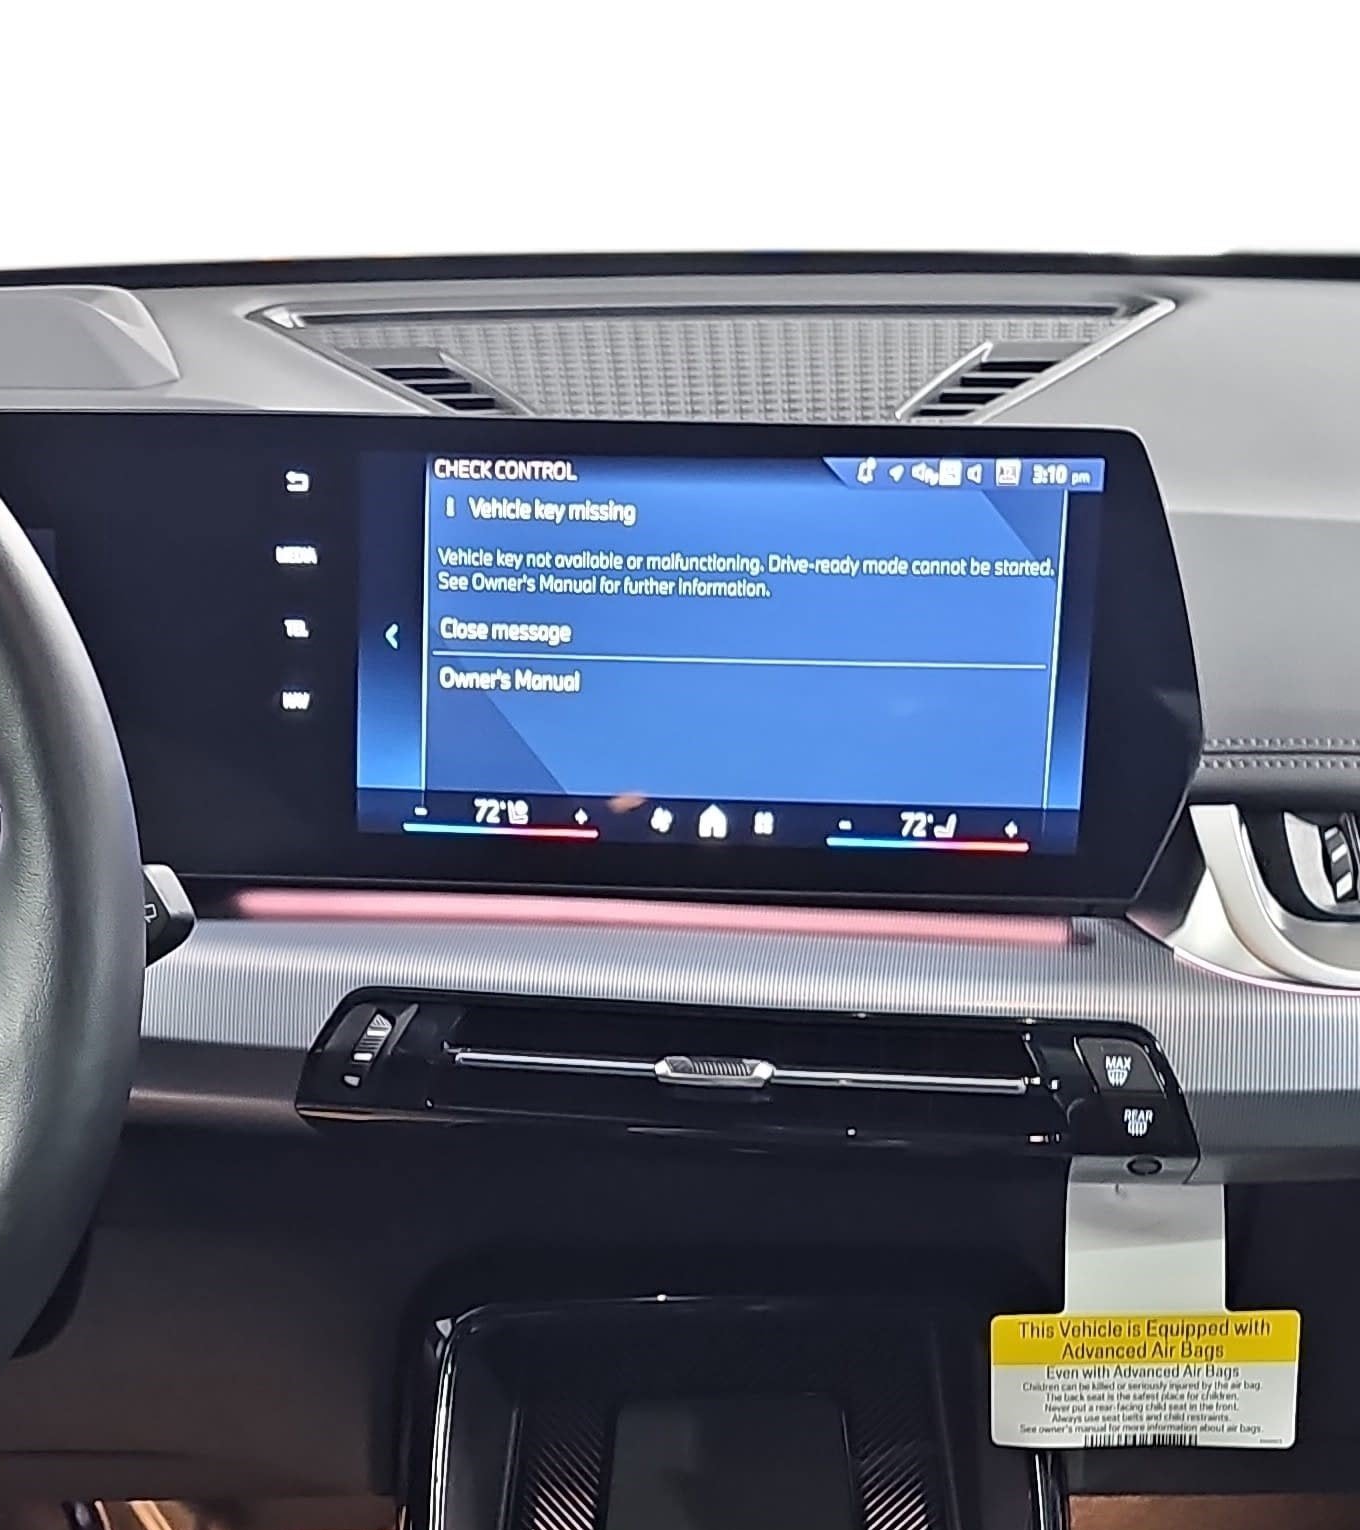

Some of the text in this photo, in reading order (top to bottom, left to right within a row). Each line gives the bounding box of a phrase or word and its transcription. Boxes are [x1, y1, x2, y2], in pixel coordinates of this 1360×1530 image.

[434, 458, 578, 482] CHECK CONTROL
[1032, 464, 1091, 486] 3:10 pm
[468, 496, 637, 526] Vehicle key missing
[437, 548, 1055, 577] Vehicle key not available or malfunctioning. Drive-ready mode cannot be started.
[438, 572, 772, 598] See Owner's Manual for further information.
[439, 616, 572, 646] Close message
[439, 666, 581, 692] Owner's Manual
[1105, 1055, 1131, 1071] MAX
[1124, 1108, 1153, 1123] REAR
[1019, 1318, 1270, 1341] This Vehicle is Equipped with
[1062, 1341, 1224, 1361] Advanced Air Bags
[1046, 1364, 1239, 1381] Even with Advanced Air Bags
[1022, 1382, 1059, 1391] Children
[1079, 1382, 1090, 1391] be
[1092, 1381, 1115, 1391] killed
[1117, 1383, 1126, 1391] or
[1128, 1381, 1167, 1392] seriously
[1169, 1381, 1199, 1392] injured
[1202, 1381, 1212, 1392] by
[1214, 1381, 1228, 1390] the
[1230, 1381, 1242, 1389] air
[1047, 1393, 1062, 1401] The
[1064, 1392, 1084, 1401] back
[1086, 1393, 1105, 1401] seat
[1107, 1392, 1114, 1400] is
[1117, 1392, 1130, 1401] the
[1132, 1391, 1159, 1400] safest
[1161, 1391, 1185, 1402] place
[1188, 1392, 1199, 1400] for
[1045, 1404, 1070, 1412] Never
[1072, 1404, 1086, 1414] put
[1145, 1402, 1166, 1411] child
[1169, 1403, 1187, 1411] seat
[1189, 1402, 1197, 1411] in
[1199, 1402, 1213, 1411] the
[1020, 1424, 1036, 1433] See
[1038, 1425, 1073, 1433] owner's
[1074, 1424, 1106, 1433] manual
[1109, 1424, 1120, 1432] for
[1122, 1424, 1145, 1432] more
[1147, 1423, 1197, 1431] information
[1199, 1424, 1224, 1433] about
[1226, 1425, 1238, 1433] air
[1052, 1414, 1082, 1424] Always
[1102, 1414, 1120, 1422] seat
[1122, 1414, 1143, 1422] belts
[1164, 1413, 1184, 1421] child
